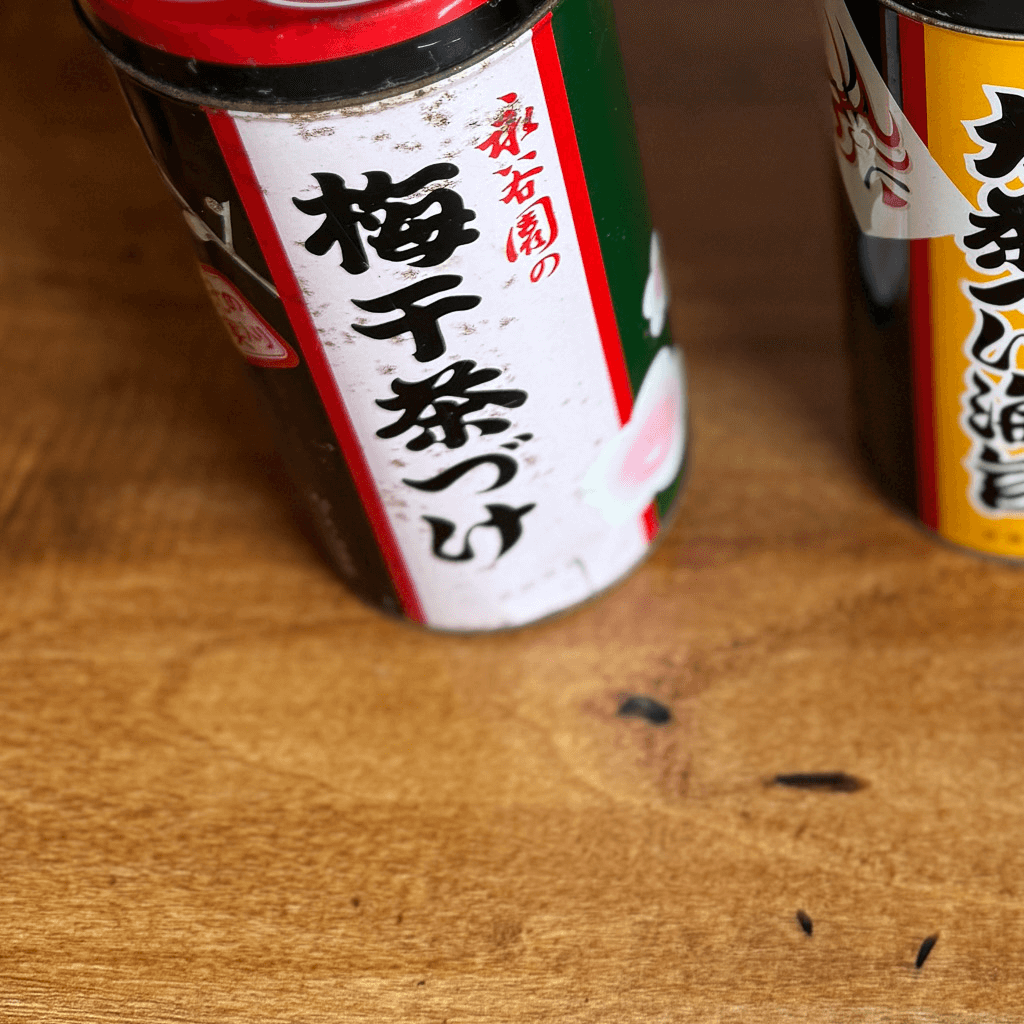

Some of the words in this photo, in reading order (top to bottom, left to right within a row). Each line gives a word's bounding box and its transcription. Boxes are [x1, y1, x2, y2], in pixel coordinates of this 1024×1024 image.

[475, 92, 560, 284] 永谷園の
[292, 162, 535, 569] 梅干茶づけ
